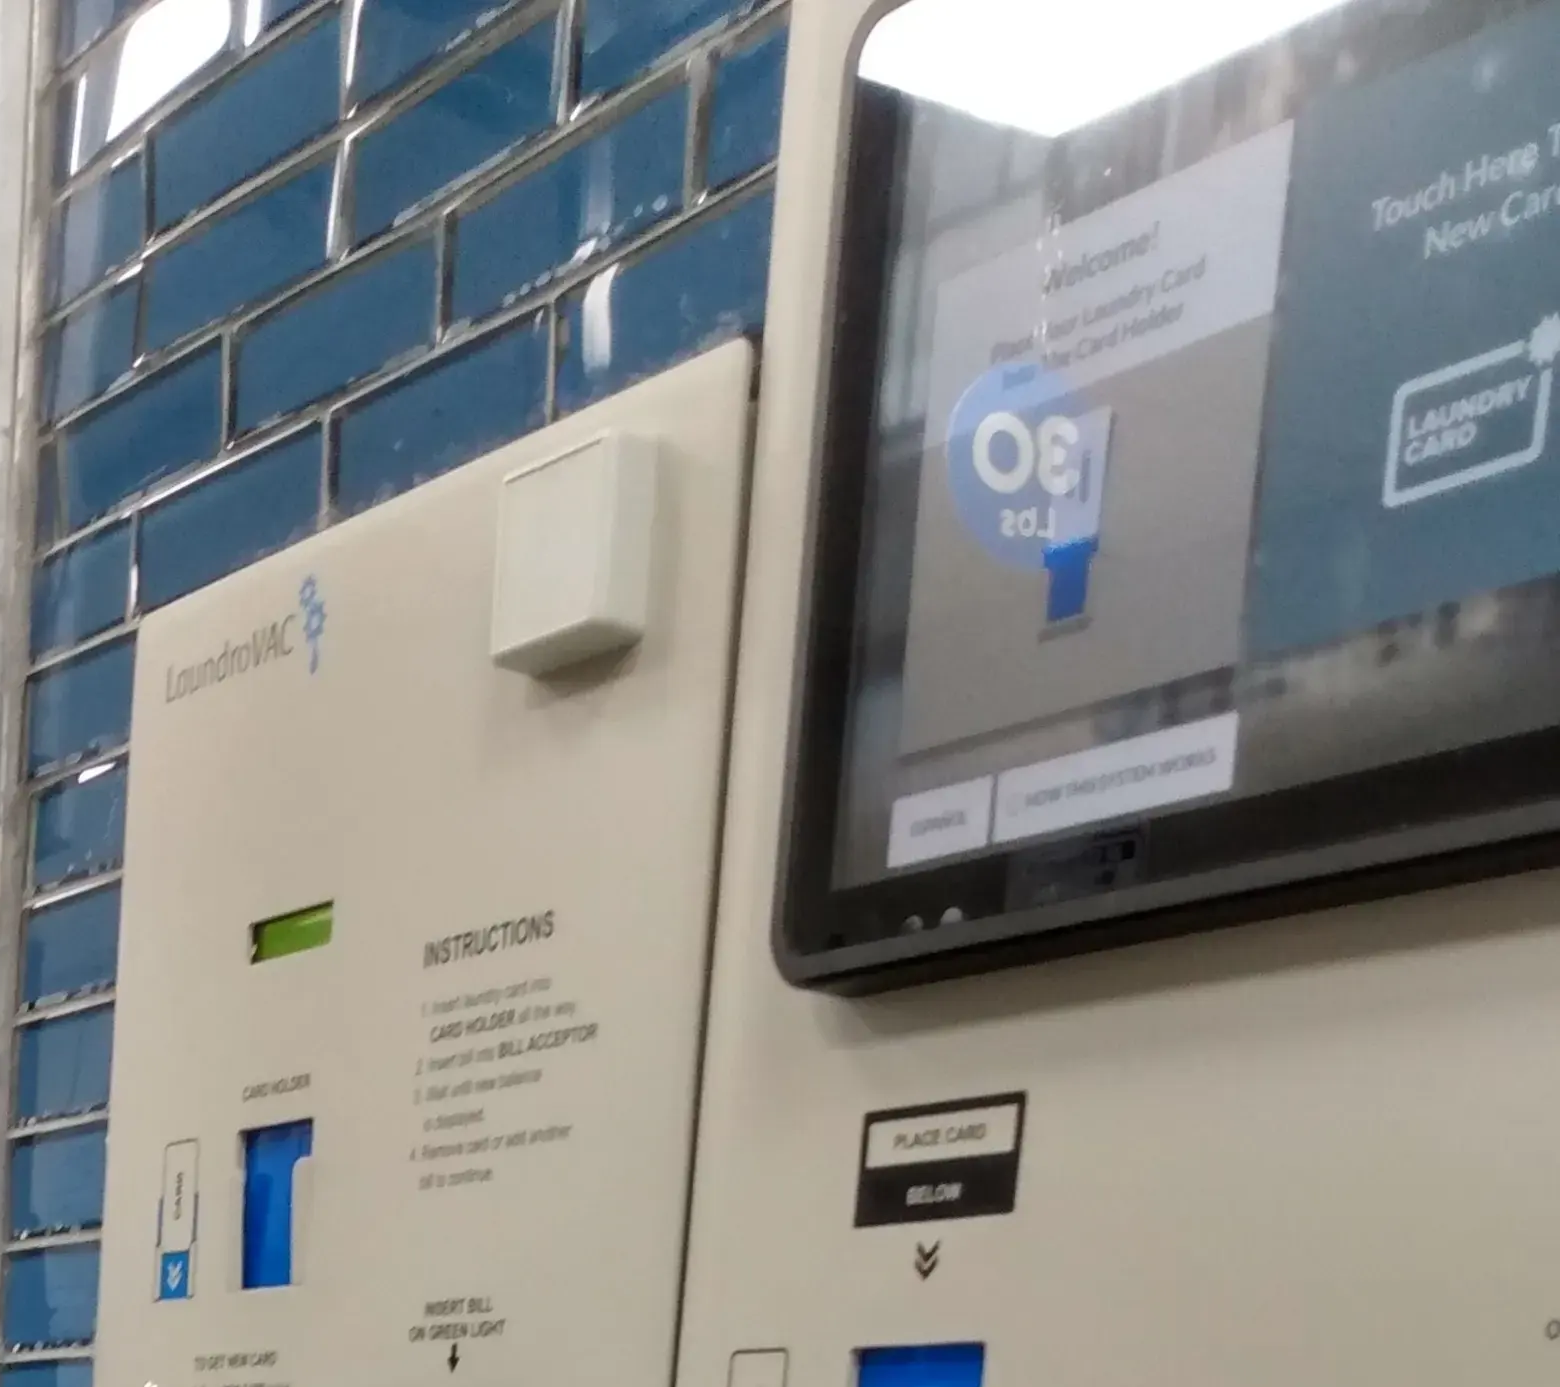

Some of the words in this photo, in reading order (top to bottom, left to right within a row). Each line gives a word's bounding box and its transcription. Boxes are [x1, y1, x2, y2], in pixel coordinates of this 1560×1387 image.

[1372, 171, 1455, 233] Touch
[1464, 141, 1539, 192] Here
[1042, 220, 1161, 295] Welcome!
[1425, 222, 1495, 260] New
[1082, 283, 1156, 327] Laundry
[1160, 253, 1209, 293] Card
[1408, 375, 1533, 440] LAUNDRY
[1404, 421, 1478, 467] CARD
[166, 613, 297, 704] LaundroVAC
[423, 909, 555, 969] INSTRUCTIONS
[465, 1008, 516, 1035] HOLDER
[527, 1022, 599, 1051] ACCEPTOR
[893, 1129, 940, 1150] PLACE
[944, 1122, 987, 1144] CARD
[906, 1182, 963, 1207] BELOW
